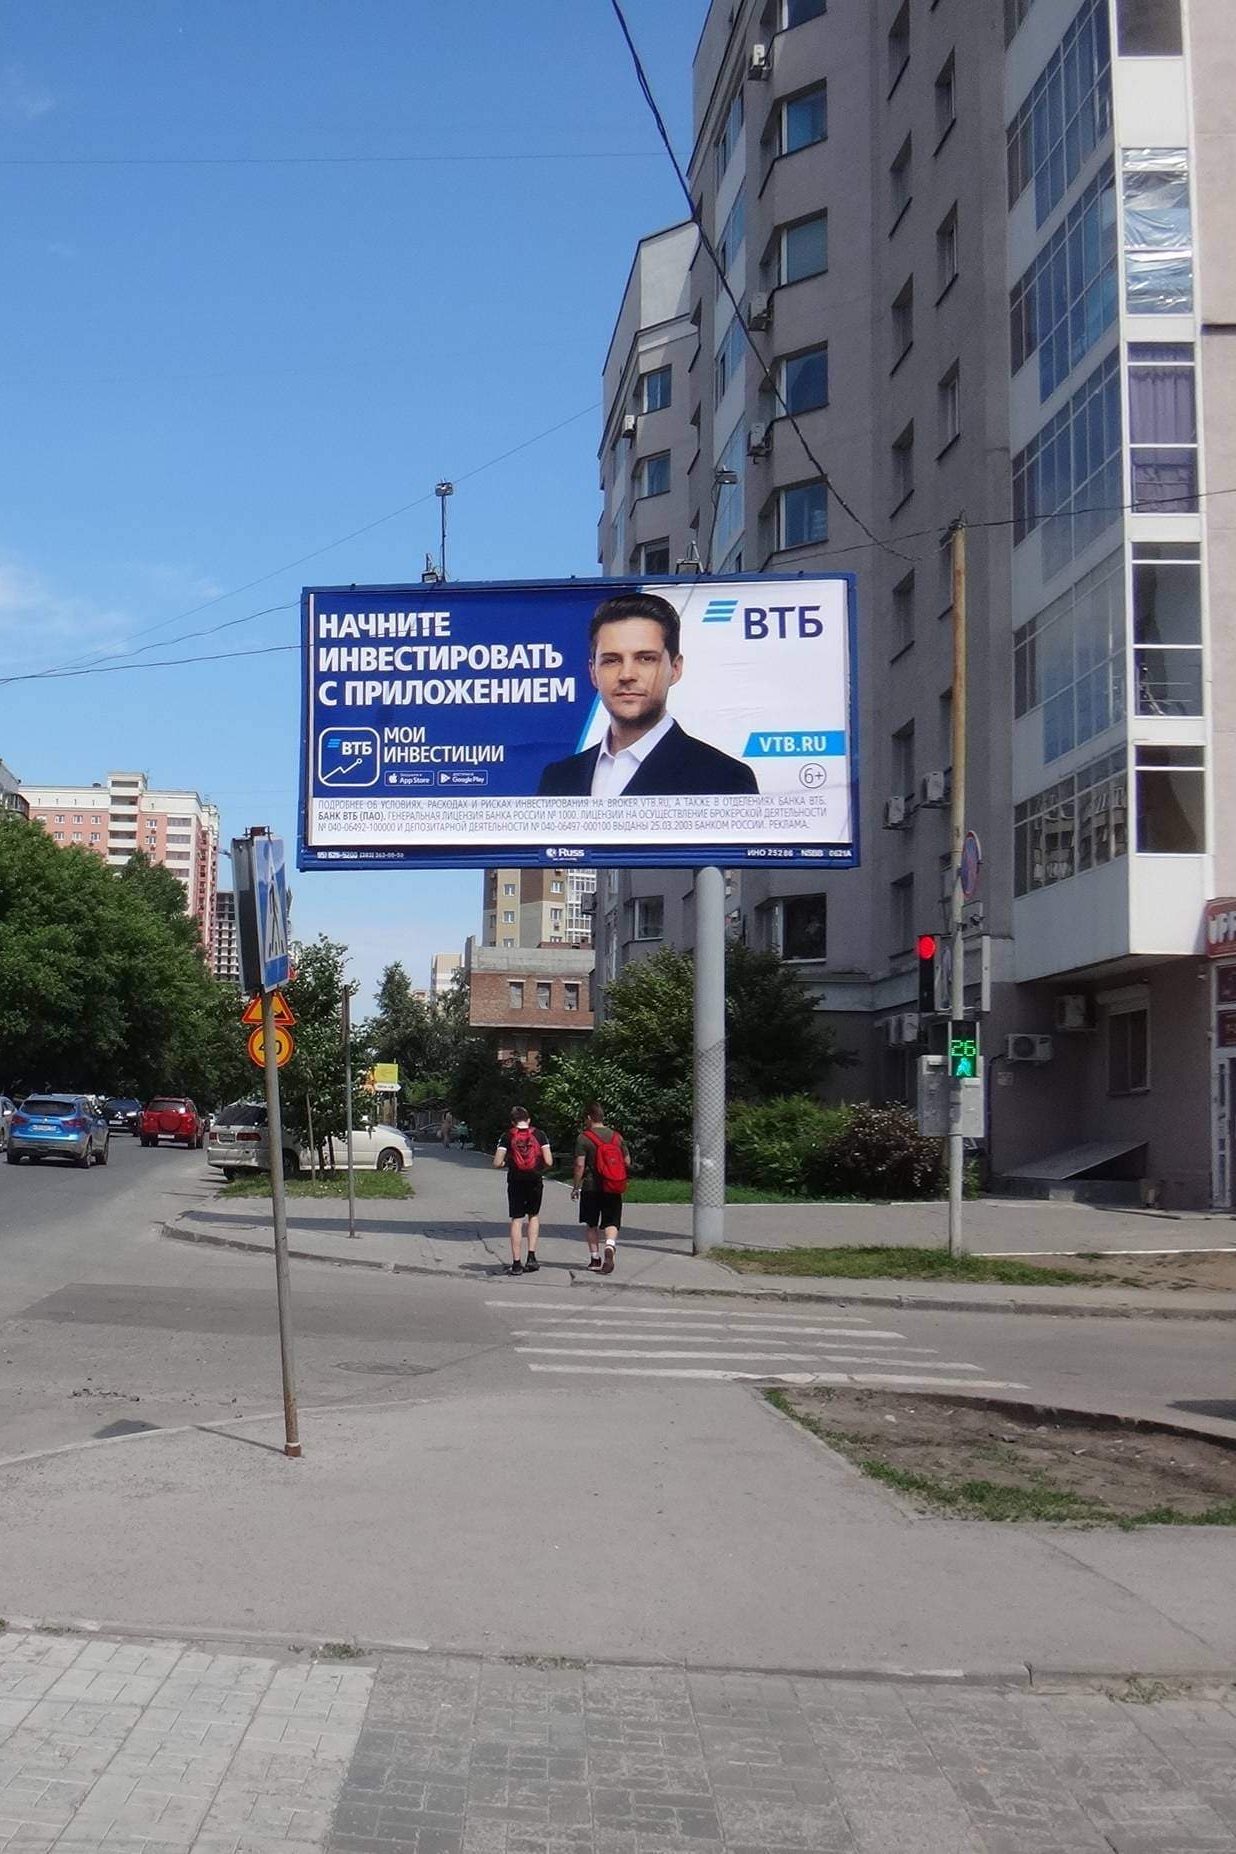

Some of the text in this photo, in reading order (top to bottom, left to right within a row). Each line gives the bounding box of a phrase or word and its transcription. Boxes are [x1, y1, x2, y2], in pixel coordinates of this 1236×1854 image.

[318, 612, 451, 639] НАЧНИТЕ
[743, 605, 824, 640] ВТБ
[318, 643, 564, 672] ИНВЕСТИРОВАТЬ
[318, 677, 576, 706] С ПРИЛОЖЕНИЕМ
[383, 726, 426, 743] МОИ
[341, 740, 373, 756] ВТБ
[758, 735, 827, 752] VTB.RU
[383, 744, 505, 765] ИНВЕСТИЦИИ
[399, 776, 430, 785] App Store
[451, 775, 485, 784] Google Play
[803, 767, 824, 784] 6+
[318, 800, 363, 810] ПОДРОБНЕЕ
[366, 800, 378, 810] ОБ
[427, 799, 468, 810] РАСХОДАХ
[471, 799, 478, 809] И
[481, 799, 512, 809] РИСКАХ
[515, 798, 589, 808] ИНВЕСТИРОВАНИЯ
[592, 798, 604, 808] НА
[675, 797, 682, 807] А
[684, 797, 710, 808] ТАКЖЕ
[714, 797, 720, 807] В
[722, 796, 775, 807] ОТДЕЛЕНИЯХ
[778, 796, 805, 806] БАНКА
[318, 811, 340, 821] БАНК
[343, 811, 357, 821] ВТБ
[360, 811, 385, 822] (ПАО).
[387, 811, 440, 821] ГЕНЕРАЛЬНАЯ
[442, 811, 484, 822] ЛИЦЕНЗИЯ
[485, 810, 511, 821] БАНКА
[513, 810, 545, 820] РОССИИ
[547, 810, 556, 820] №
[580, 809, 624, 821] ЛИЦЕНЗИИ
[626, 809, 637, 819] НА
[639, 808, 708, 820] ОСУЩЕСТВЛЕНИЕ
[709, 807, 762, 818] БРОКЕРСКОЙ
[764, 807, 827, 818] ДЕЯТЕЛЬНОСТИ
[397, 822, 404, 832] И
[404, 821, 467, 833] ДЕПОЗИТАРНОЙ
[468, 821, 529, 832] ДЕЯТЕЛЬНОСТИ
[613, 821, 649, 831] ВЫДАНЫ
[650, 820, 692, 831] 25.03.2003
[695, 820, 729, 831] БАНКОМ
[558, 847, 585, 857] Russ
[951, 1040, 976, 1057] 26
